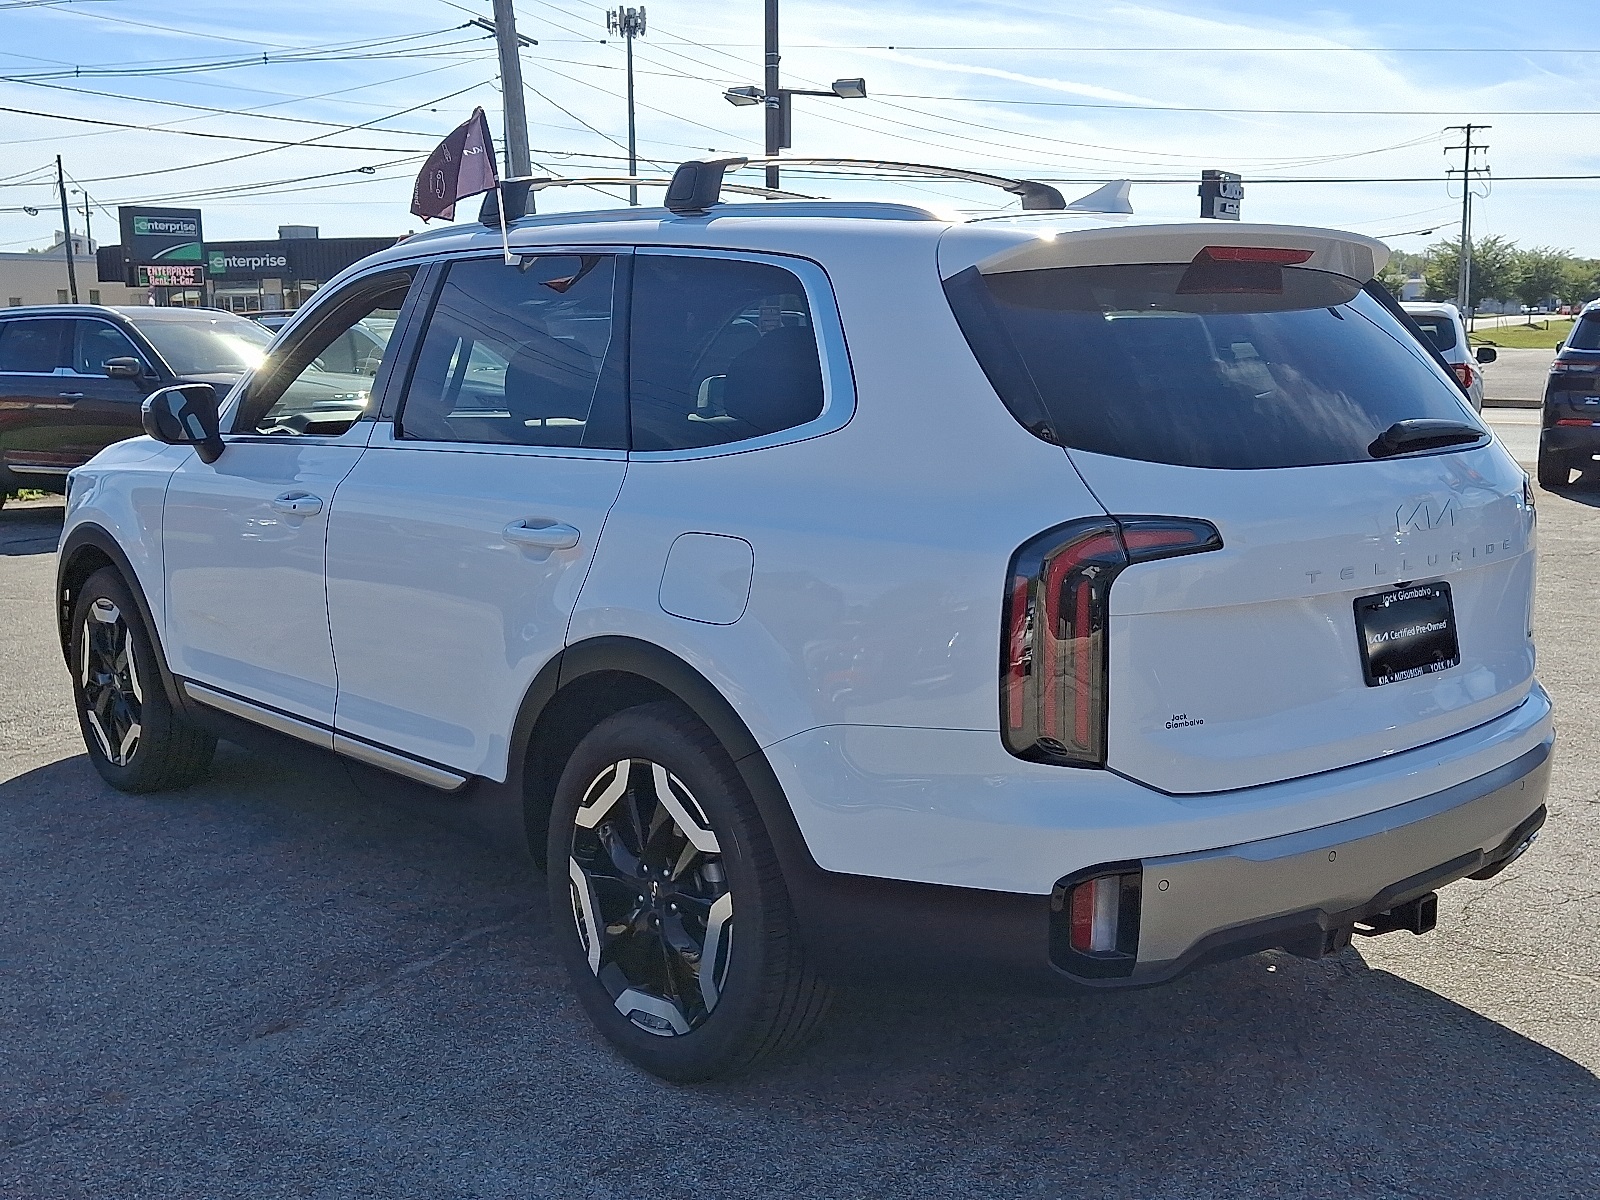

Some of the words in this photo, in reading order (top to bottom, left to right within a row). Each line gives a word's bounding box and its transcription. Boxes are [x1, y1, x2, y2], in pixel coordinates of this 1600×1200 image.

[138, 221, 196, 232] enterprise
[212, 253, 287, 270] enterprise
[147, 266, 195, 276] ENTERPRISE
[149, 275, 194, 285] Rent-A-Car
[1305, 539, 1510, 584] TELLURIDE
[1382, 593, 1398, 604] Jack
[1398, 587, 1432, 601] Giambalvo
[1390, 625, 1415, 640] Certified
[1416, 620, 1447, 634] Pre-Owned
[1378, 675, 1390, 685] KIA
[1394, 667, 1424, 681] MITSUBISHI
[1165, 719, 1204, 729] Giambalvo
[1171, 713, 1188, 721] Jack
